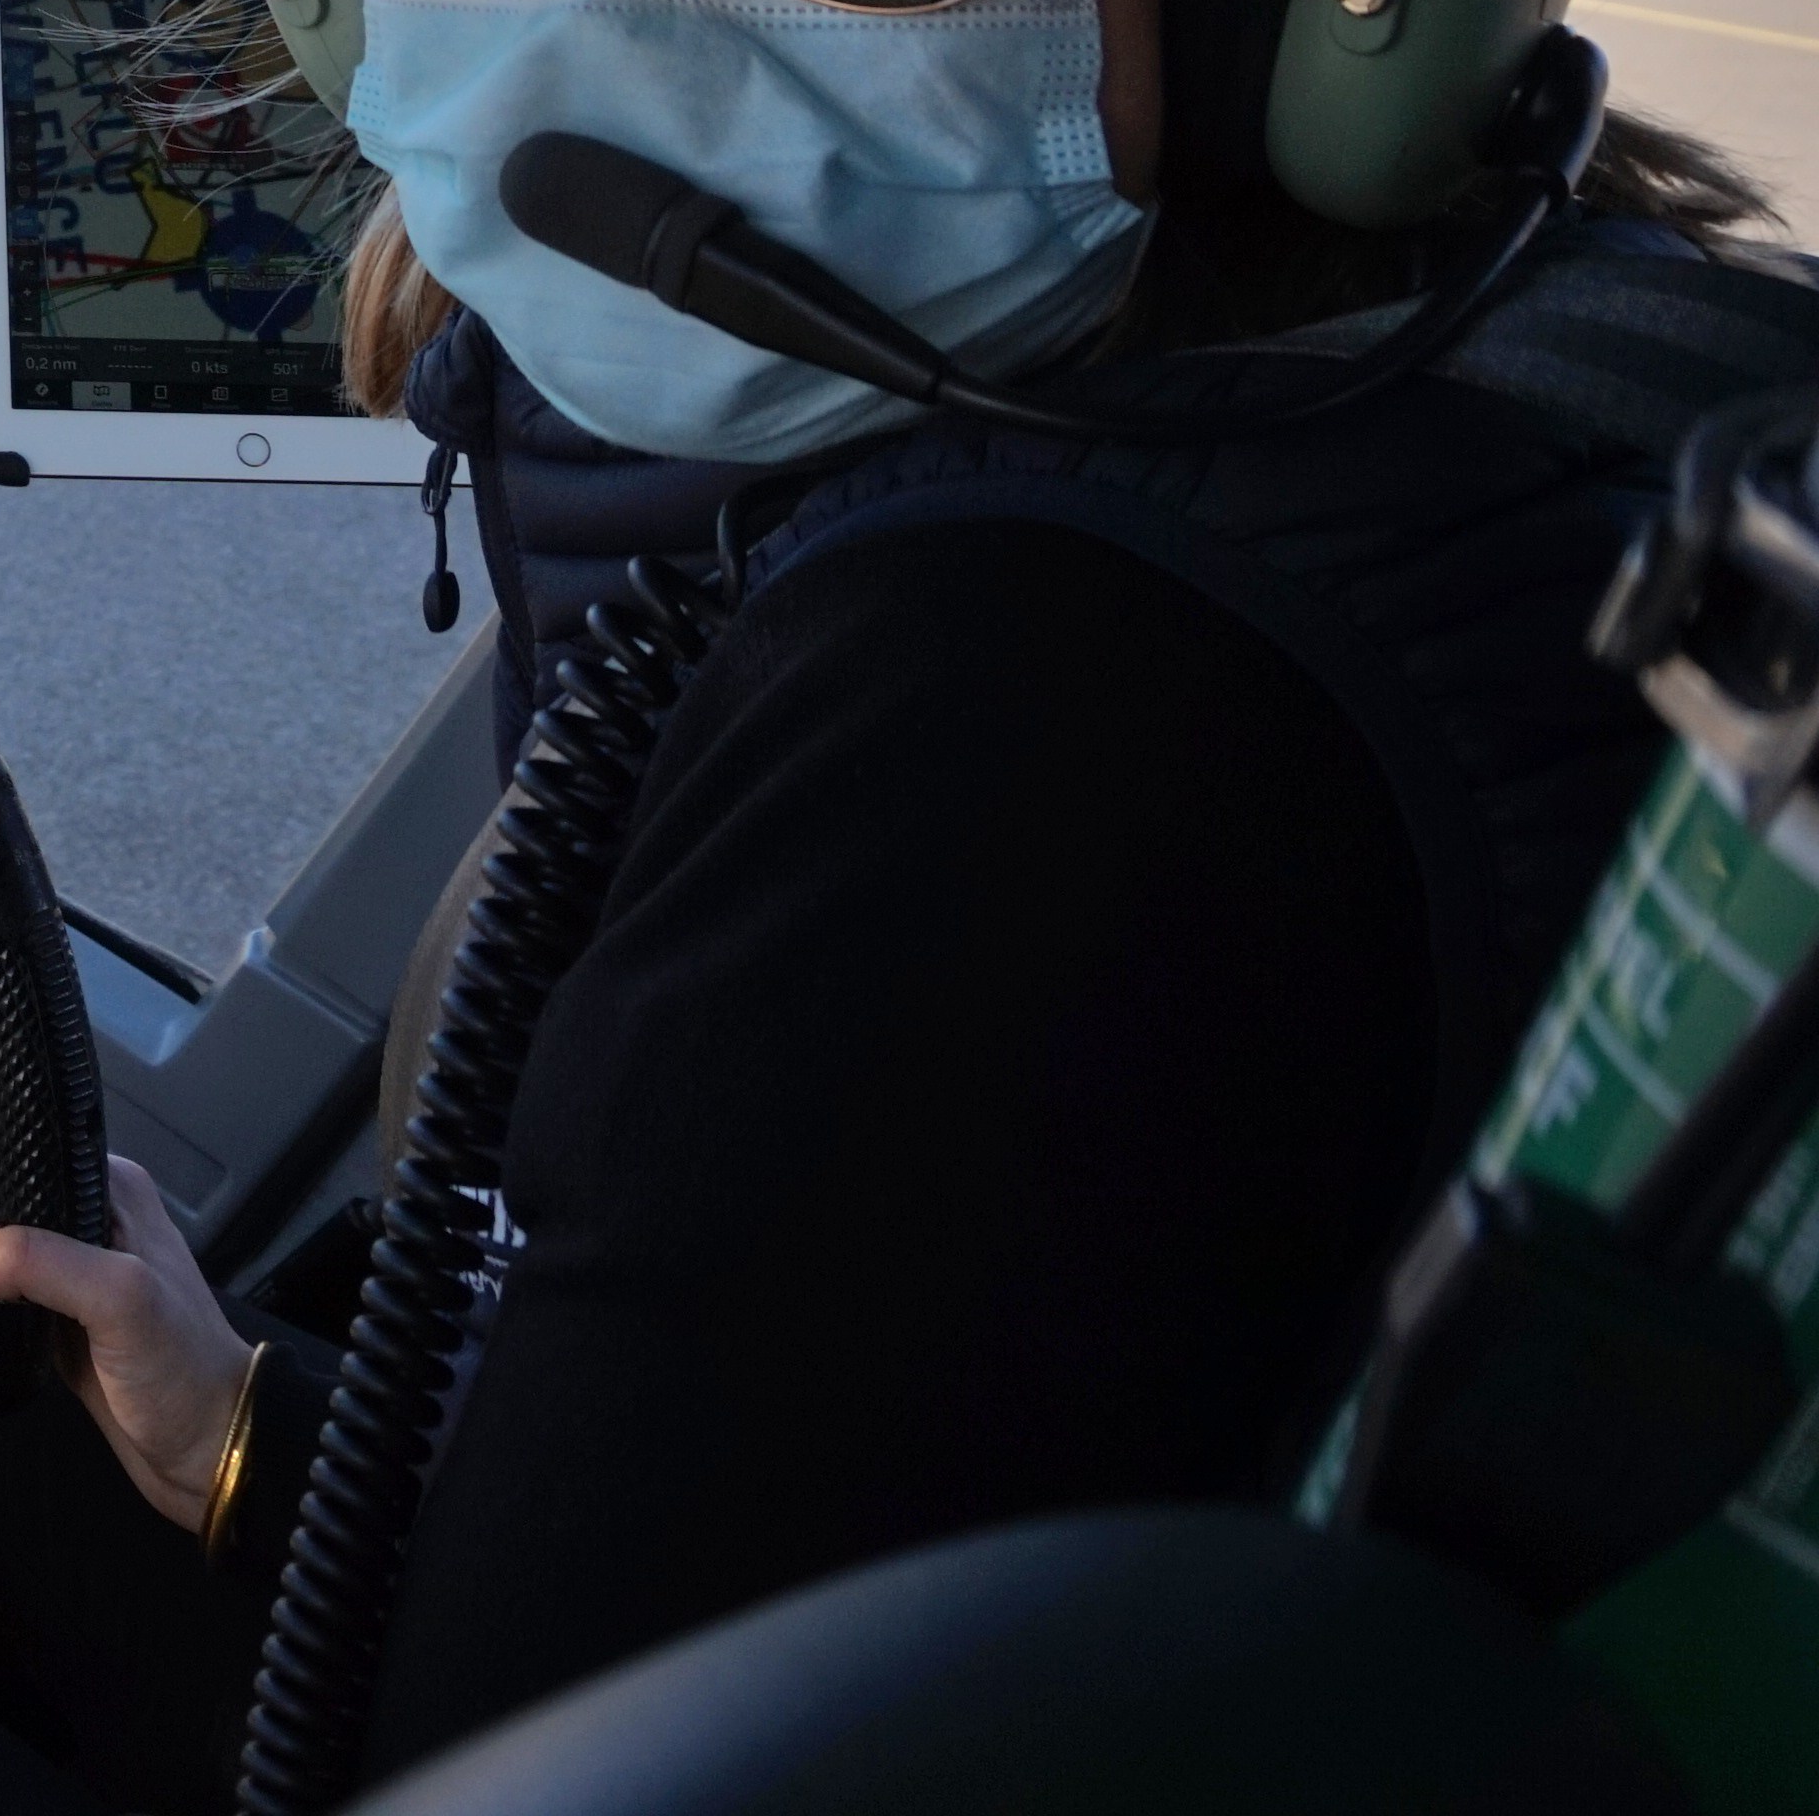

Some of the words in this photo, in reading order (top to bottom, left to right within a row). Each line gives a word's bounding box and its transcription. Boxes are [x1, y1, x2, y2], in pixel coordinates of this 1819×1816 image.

[25, 356, 48, 372] 0,2
[53, 359, 77, 372] nm
[191, 360, 200, 373] 0
[205, 360, 228, 375] kts
